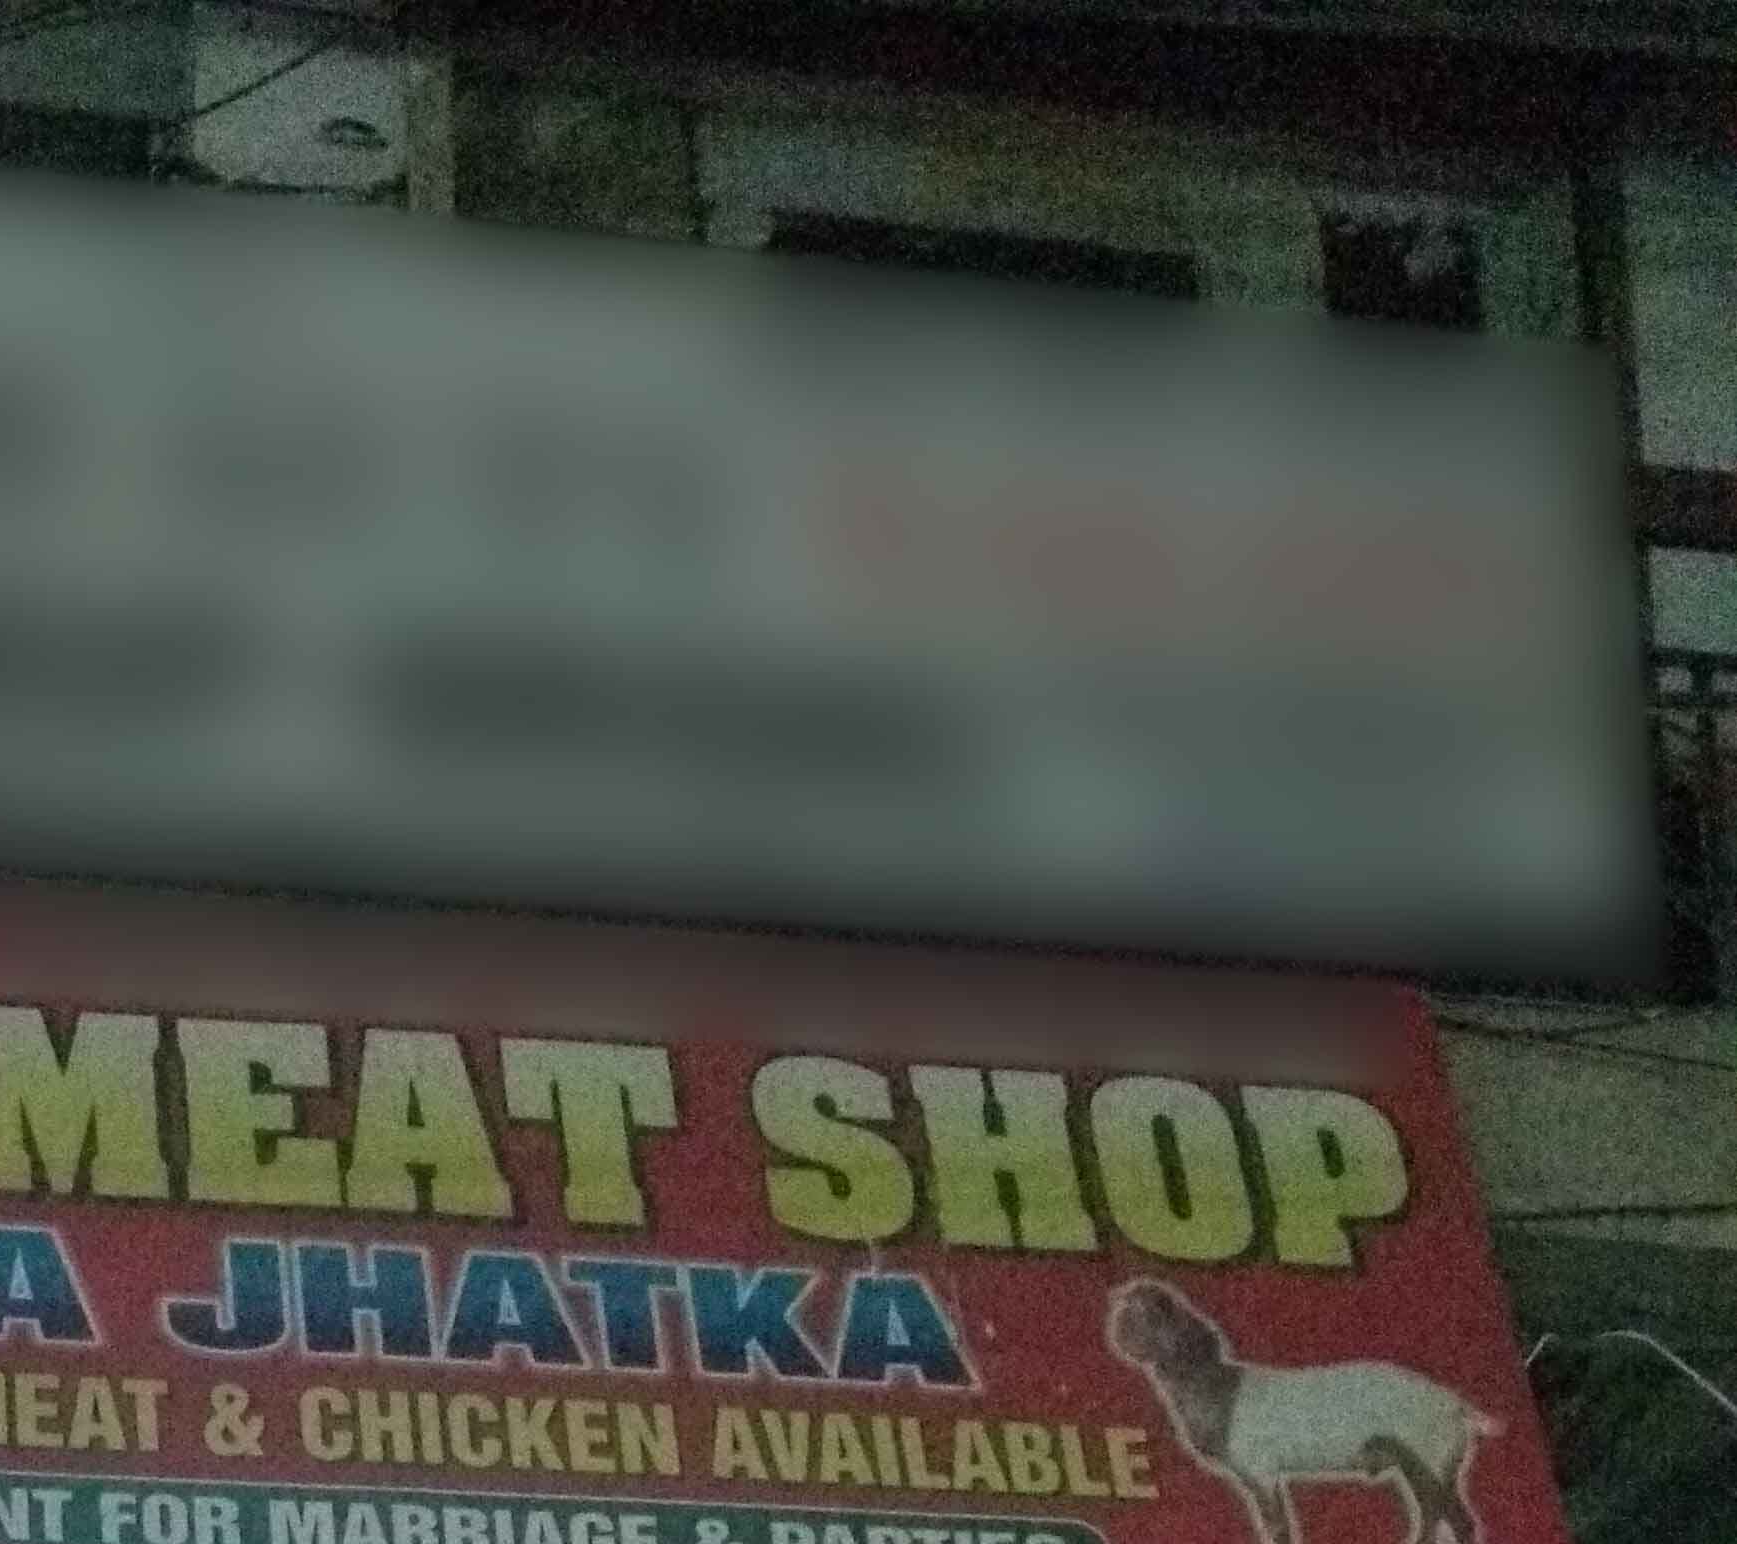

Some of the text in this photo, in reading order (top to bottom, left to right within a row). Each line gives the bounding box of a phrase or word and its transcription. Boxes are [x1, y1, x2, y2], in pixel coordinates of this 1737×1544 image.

[748, 1052, 1411, 1270] SHOP
[159, 1236, 985, 1394] JHATKA
[203, 1383, 266, 1462] &
[299, 1384, 680, 1480] CHICKEN
[711, 1408, 1158, 1502] AVAILABLE
